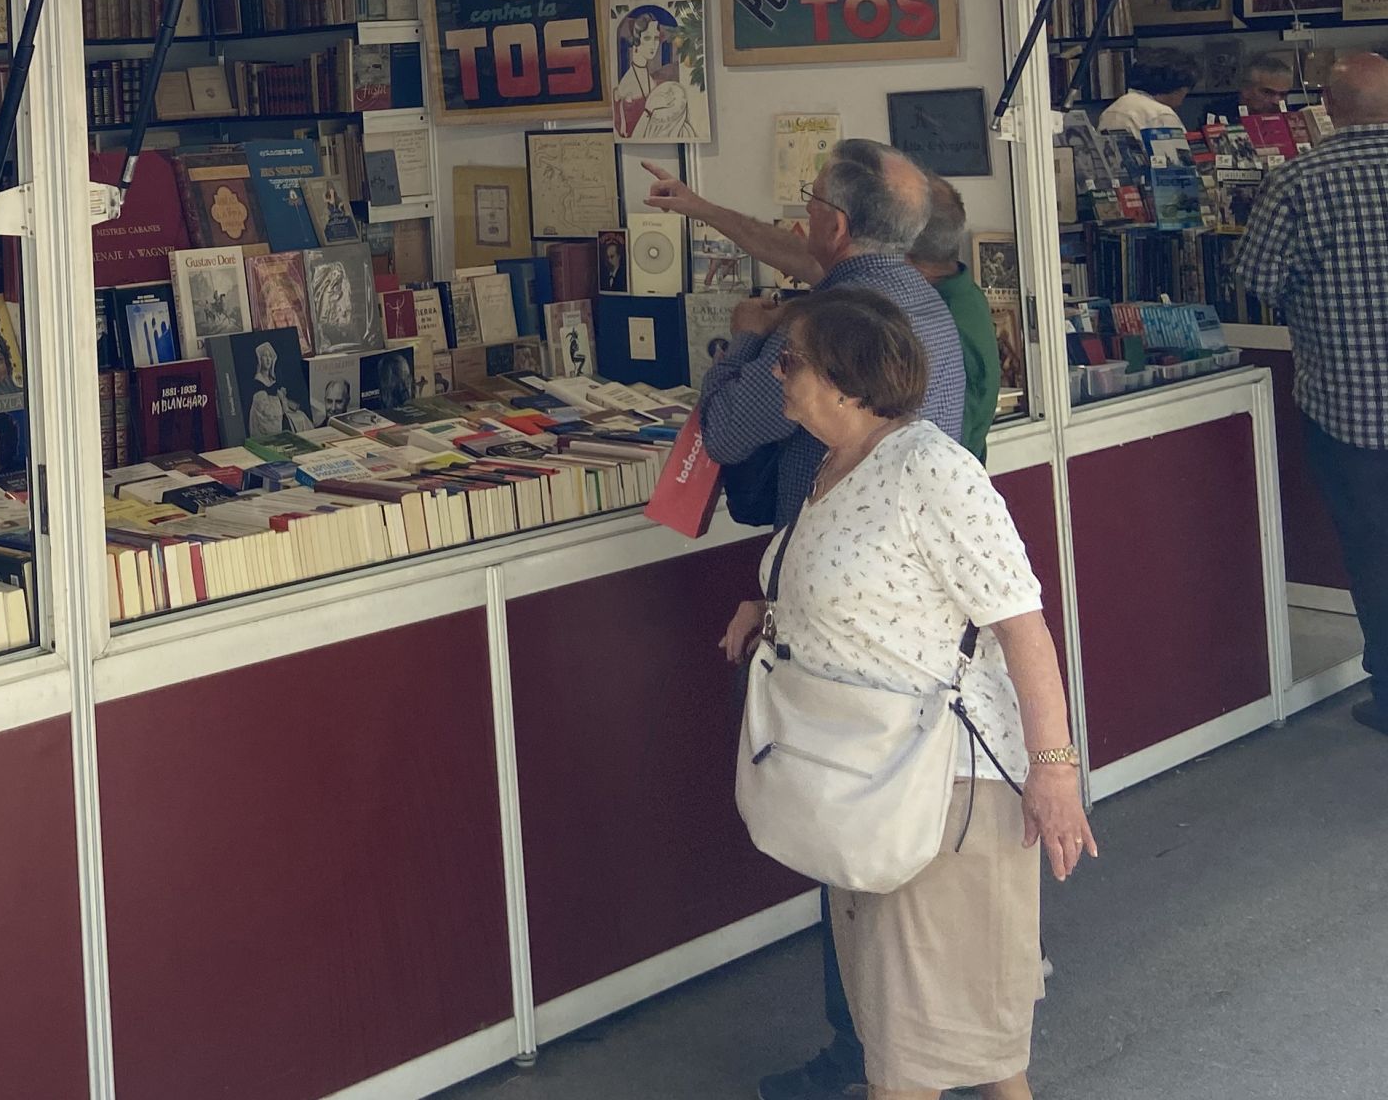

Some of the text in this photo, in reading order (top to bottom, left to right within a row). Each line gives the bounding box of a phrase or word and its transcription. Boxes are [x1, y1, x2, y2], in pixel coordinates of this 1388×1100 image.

[469, 0, 557, 23] contra la
[445, 17, 594, 102] TOS
[92, 250, 124, 261] ENAJE
[127, 250, 136, 259] A
[161, 394, 208, 412] BLANCHARD
[675, 429, 703, 484] todocol
